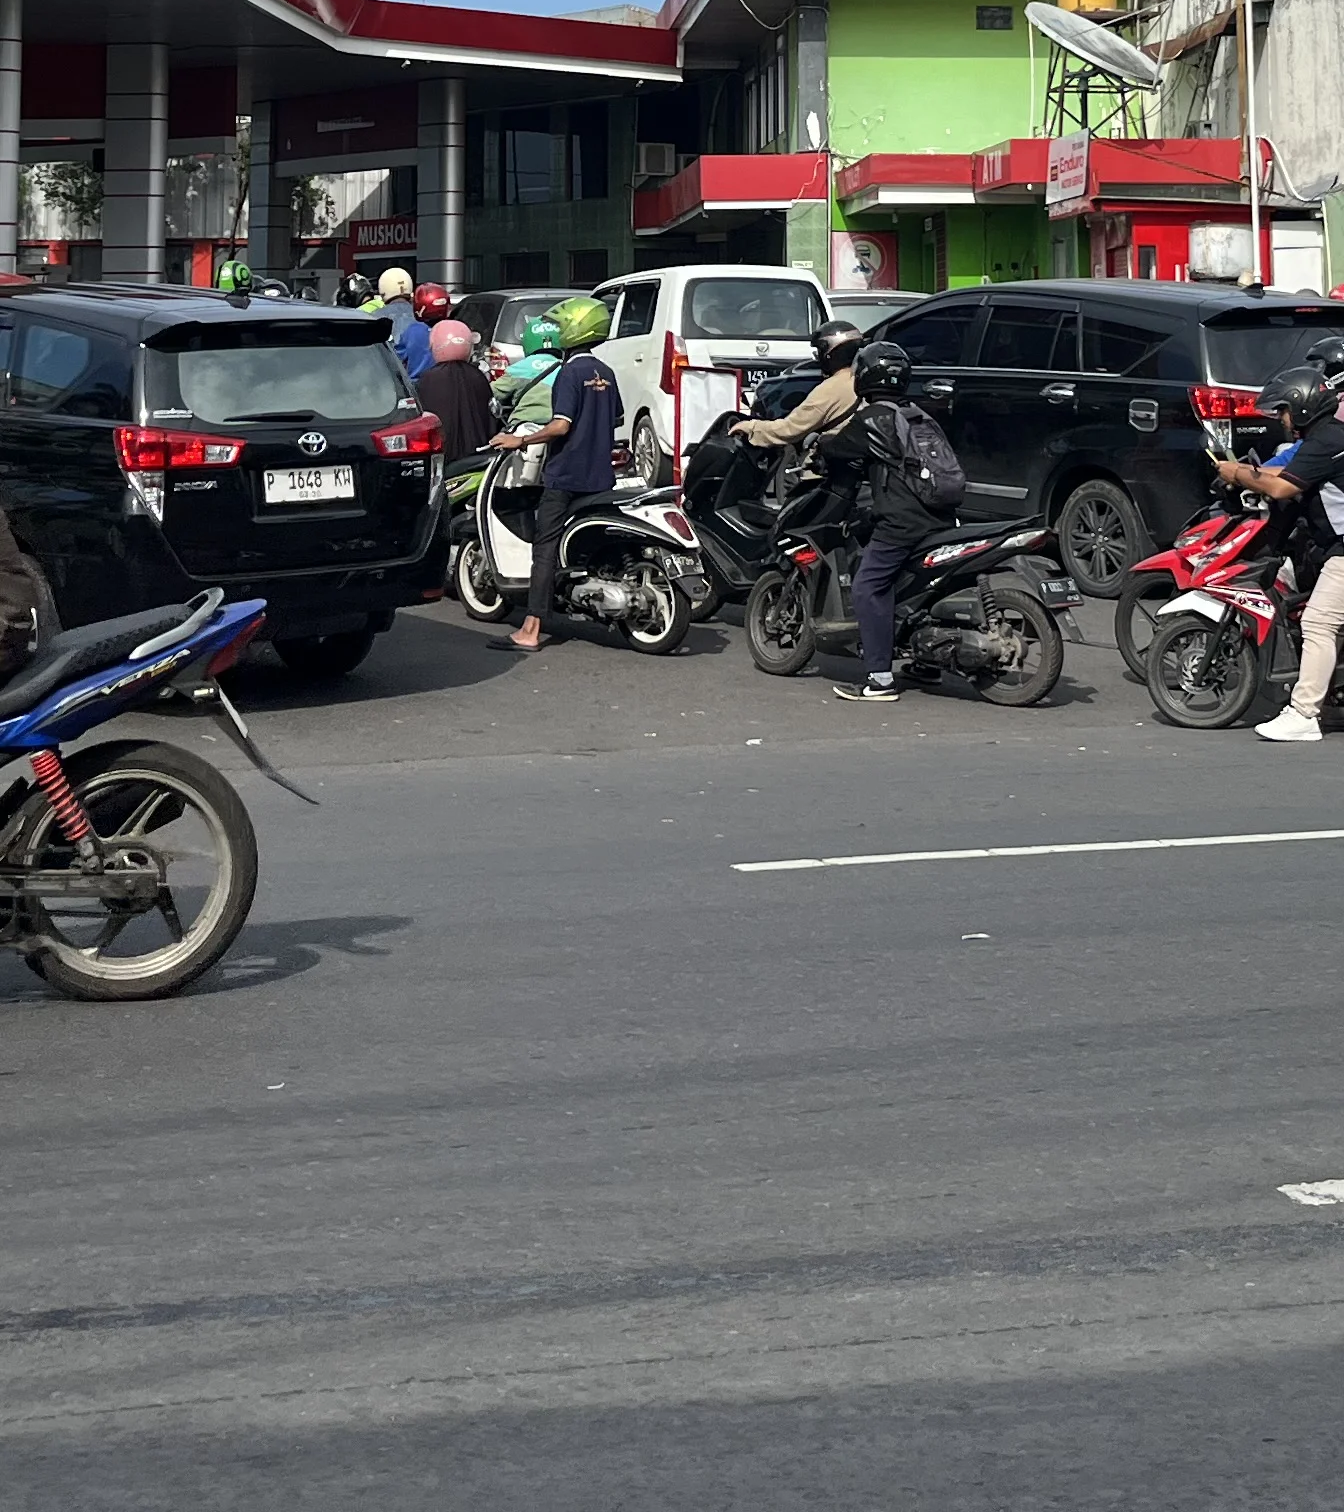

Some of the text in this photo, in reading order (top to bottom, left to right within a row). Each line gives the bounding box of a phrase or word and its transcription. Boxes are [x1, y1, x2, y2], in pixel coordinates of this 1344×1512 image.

[982, 150, 1002, 185] ATM
[267, 472, 275, 491] P
[288, 470, 323, 490] 1648
